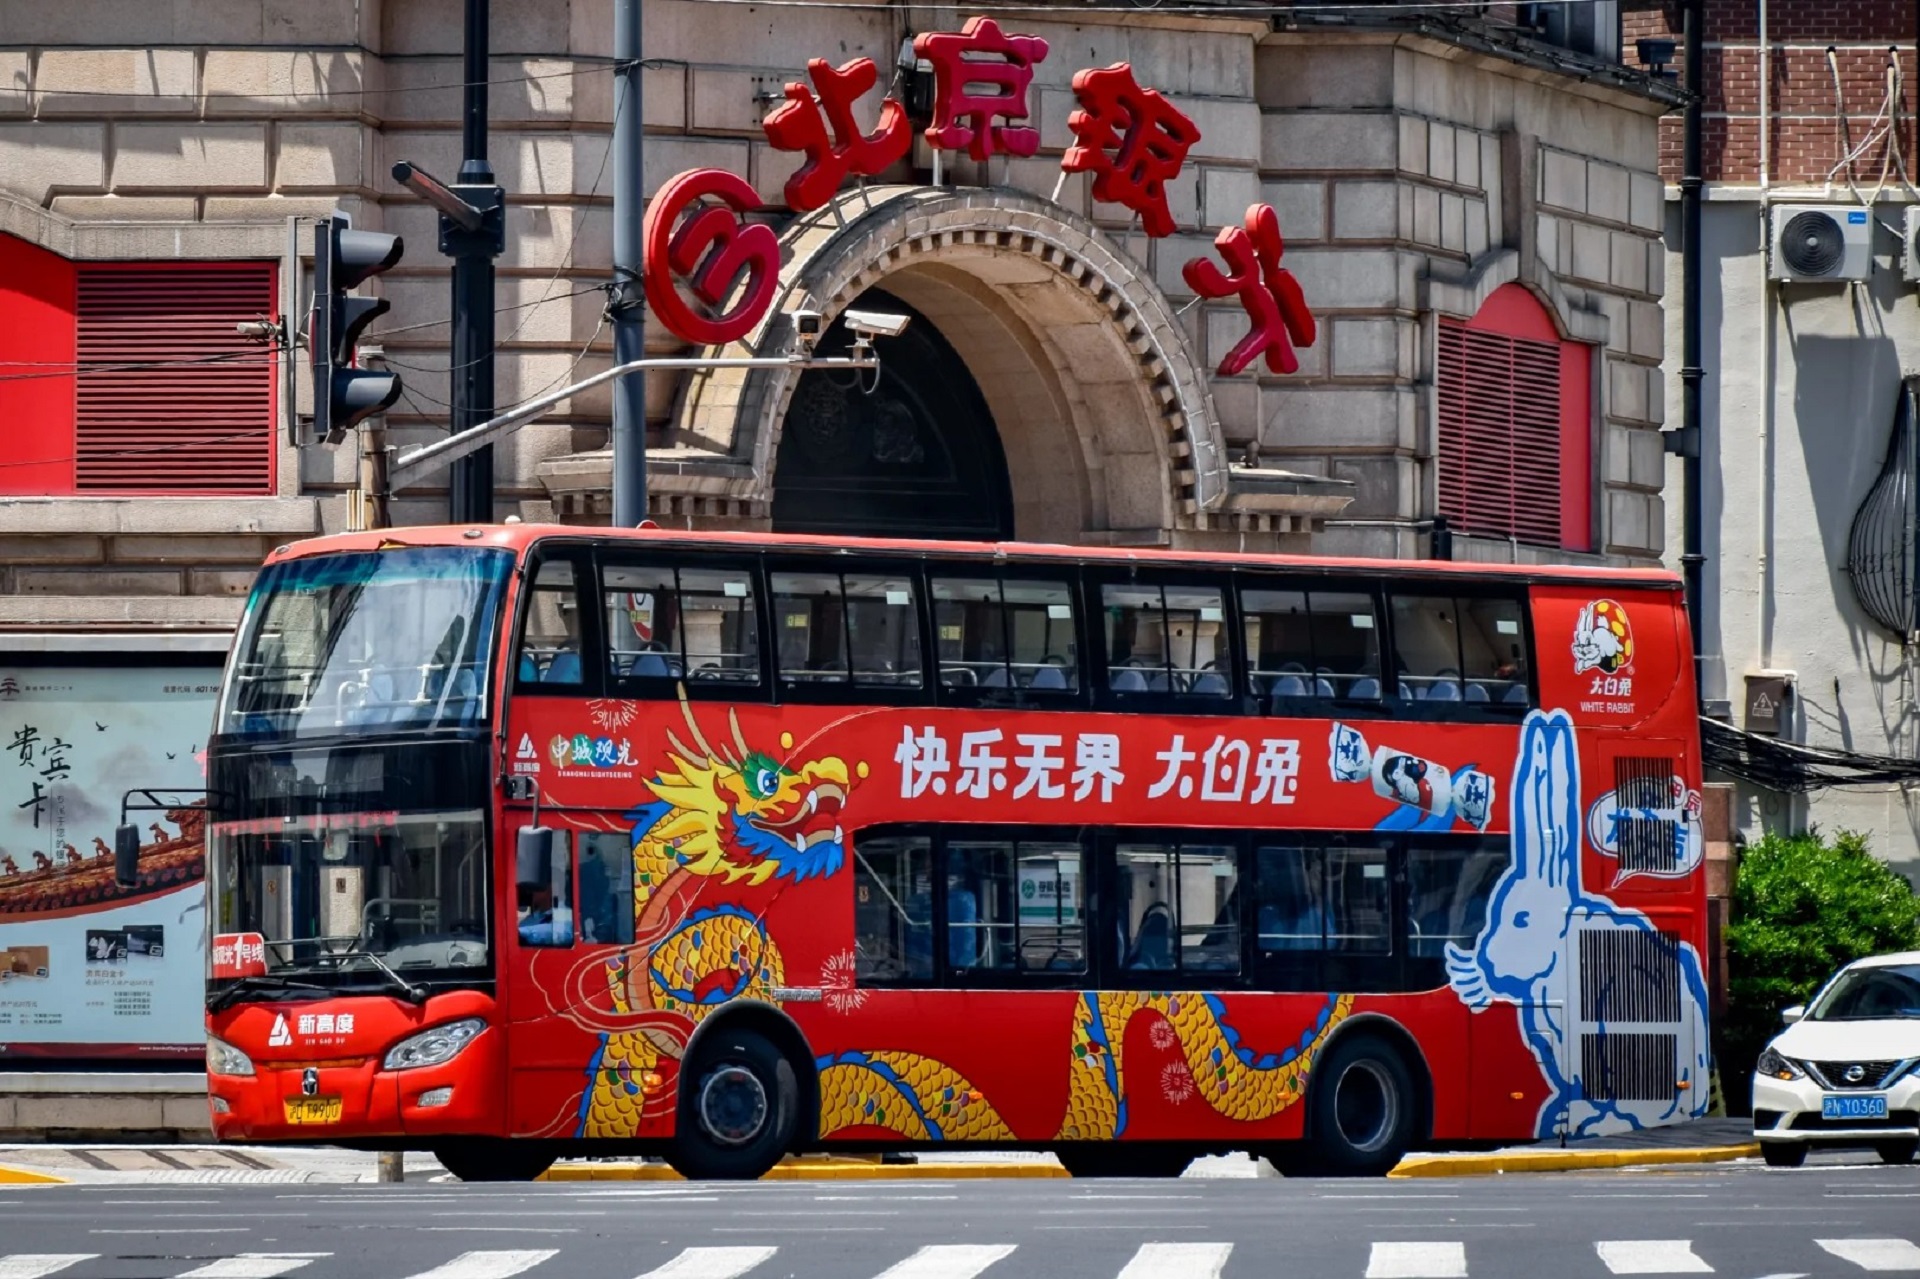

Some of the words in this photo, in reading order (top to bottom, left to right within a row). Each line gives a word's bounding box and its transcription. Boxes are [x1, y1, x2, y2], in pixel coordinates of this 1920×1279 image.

[1589, 675, 1632, 697] 大白兔
[1580, 701, 1605, 713] WHITE
[1606, 702, 1636, 714] RABBIT
[551, 733, 639, 770] 申城观光
[894, 724, 1125, 803] 快乐无界
[1147, 734, 1301, 805] 大白兔
[298, 1013, 355, 1035] 新高度
